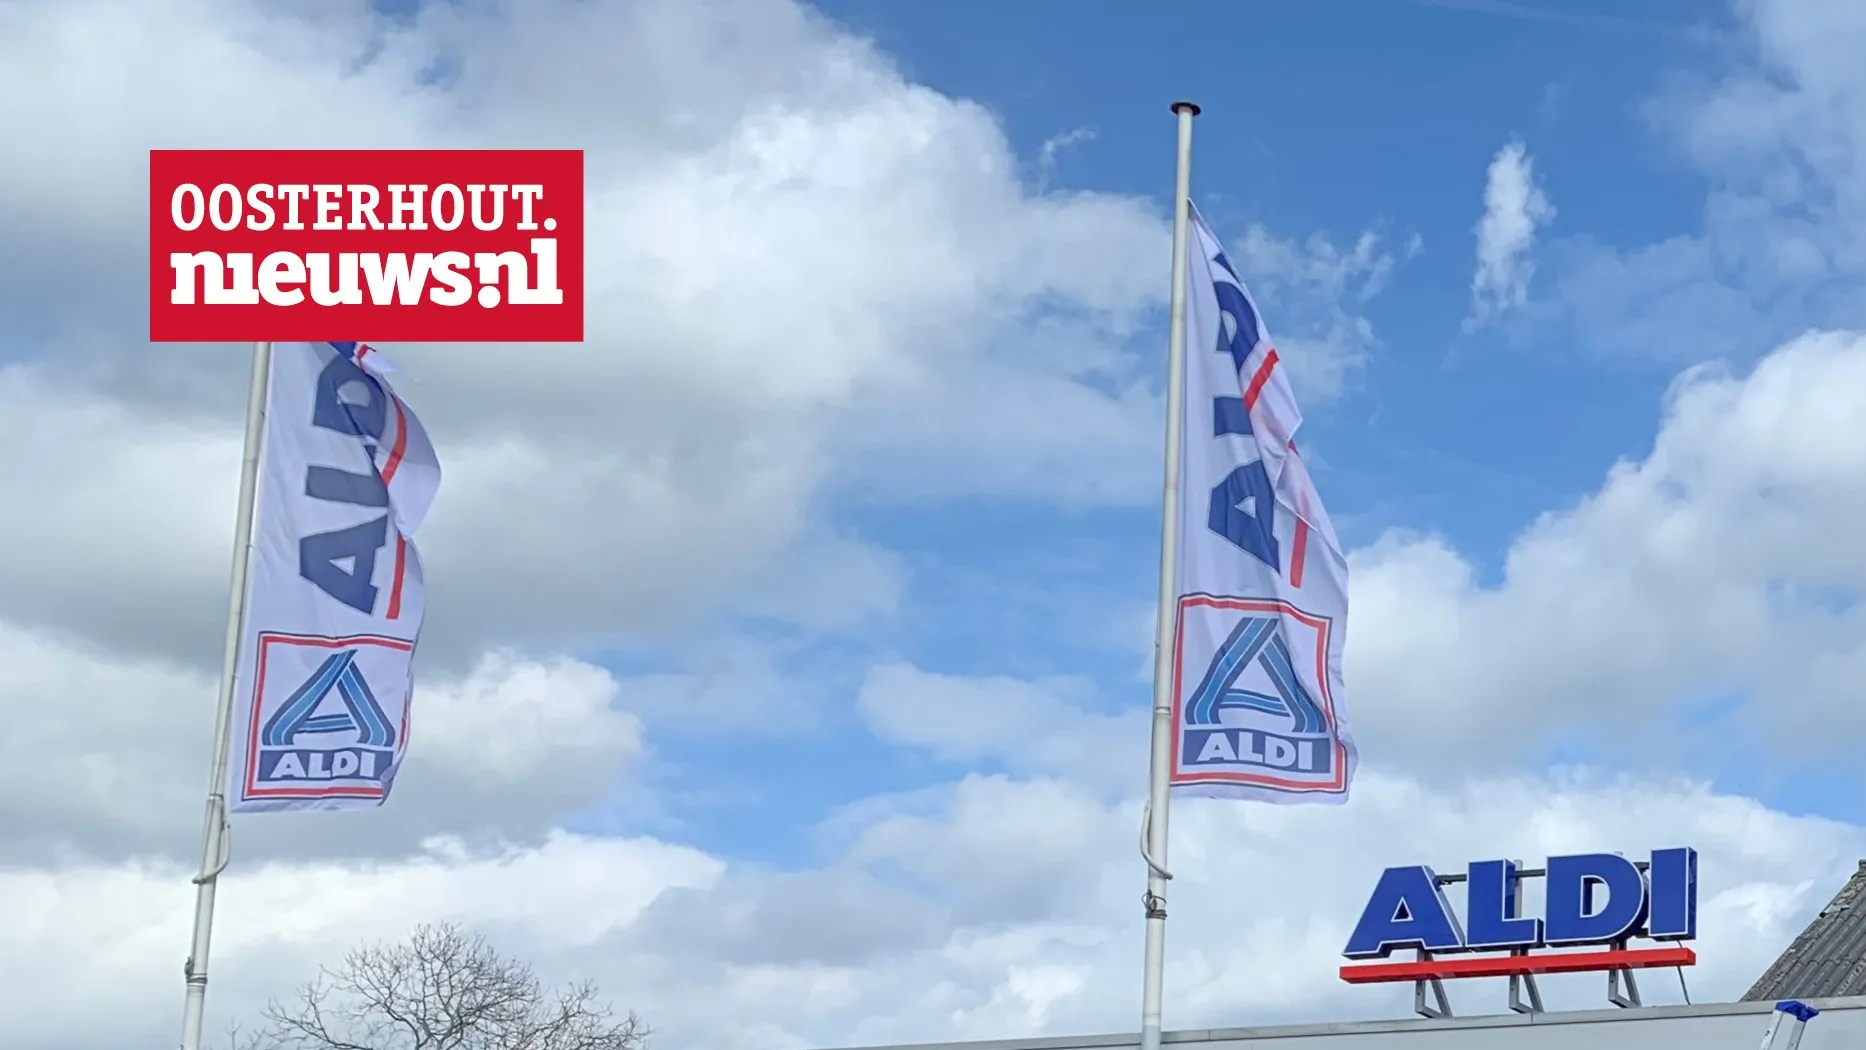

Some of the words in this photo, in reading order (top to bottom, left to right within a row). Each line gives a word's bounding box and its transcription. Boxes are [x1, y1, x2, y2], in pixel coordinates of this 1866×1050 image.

[267, 750, 375, 781] ALDI
[1196, 732, 1314, 771] ALDI
[1341, 846, 1698, 960] ALDI
